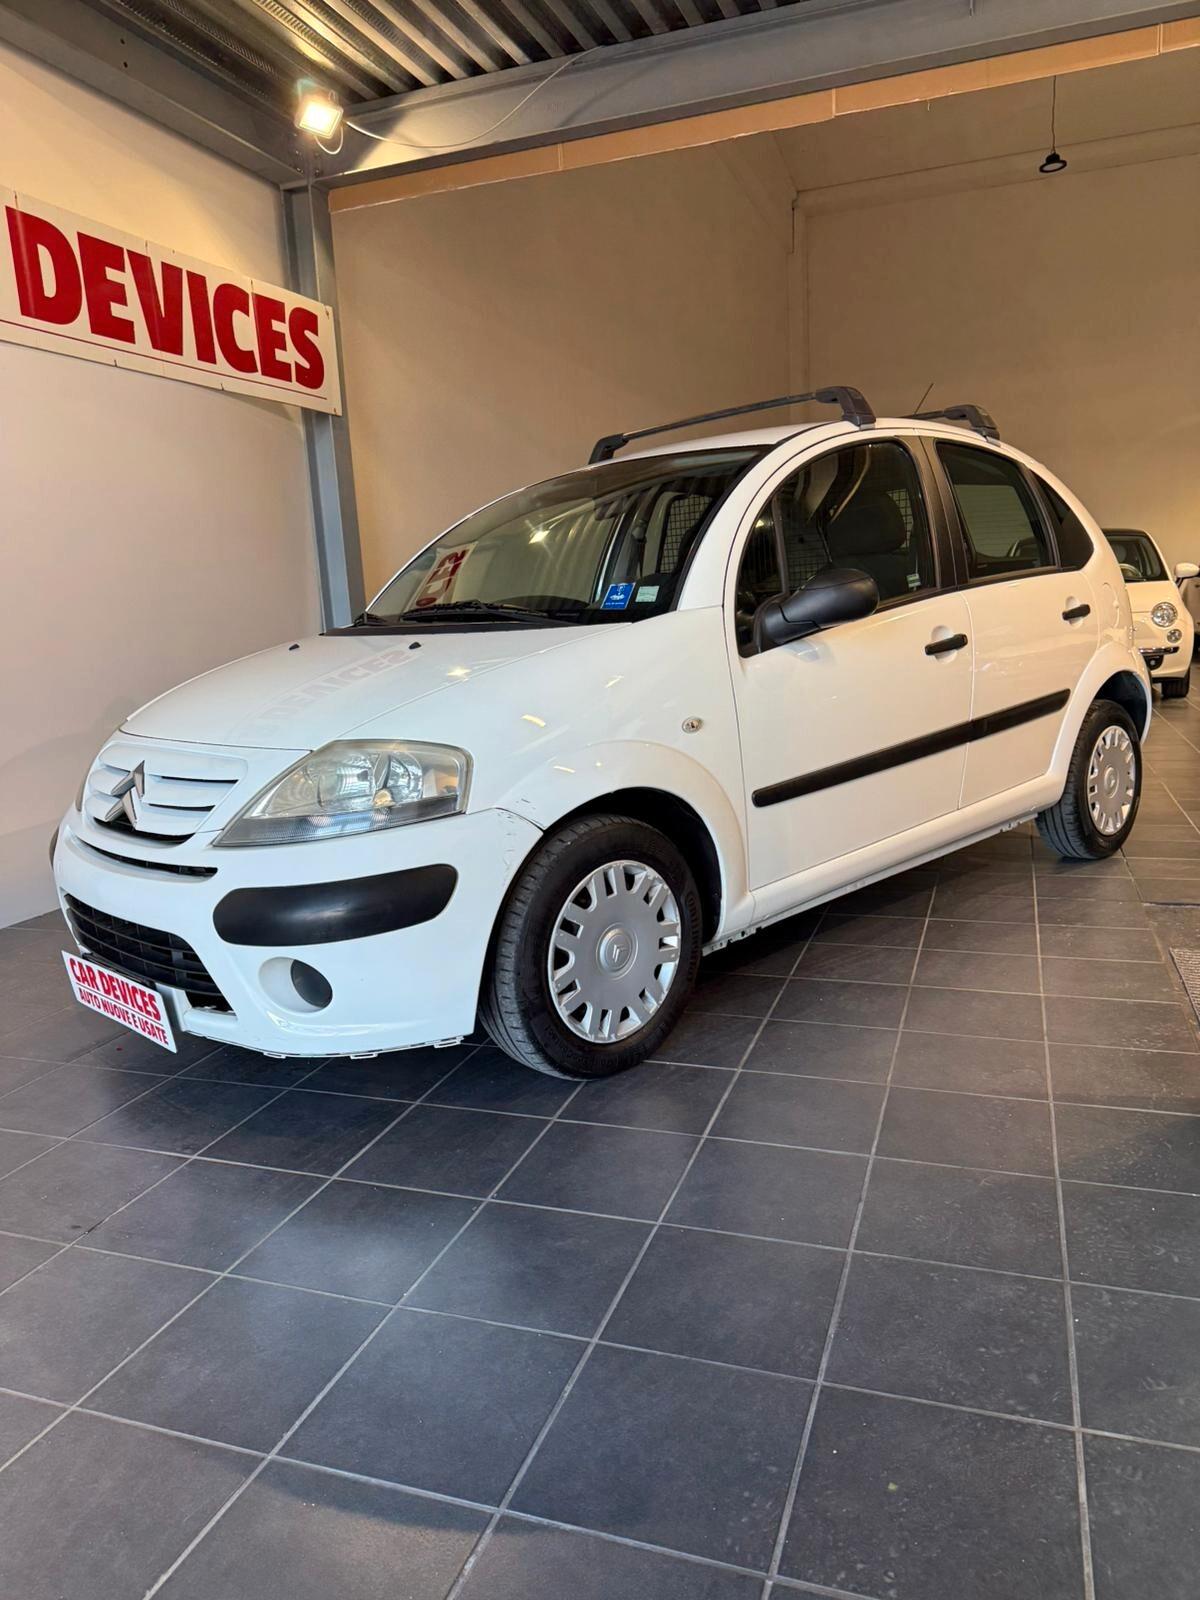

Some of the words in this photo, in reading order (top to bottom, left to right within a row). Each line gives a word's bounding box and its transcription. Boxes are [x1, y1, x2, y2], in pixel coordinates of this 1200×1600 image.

[5, 205, 325, 390] DEVICES
[69, 957, 99, 991] CAR
[98, 969, 161, 1021] DEVICES
[79, 987, 101, 1010] AUTO
[101, 998, 133, 1025] NUOVE
[131, 1016, 139, 1029] E
[139, 1018, 169, 1045] USATE
